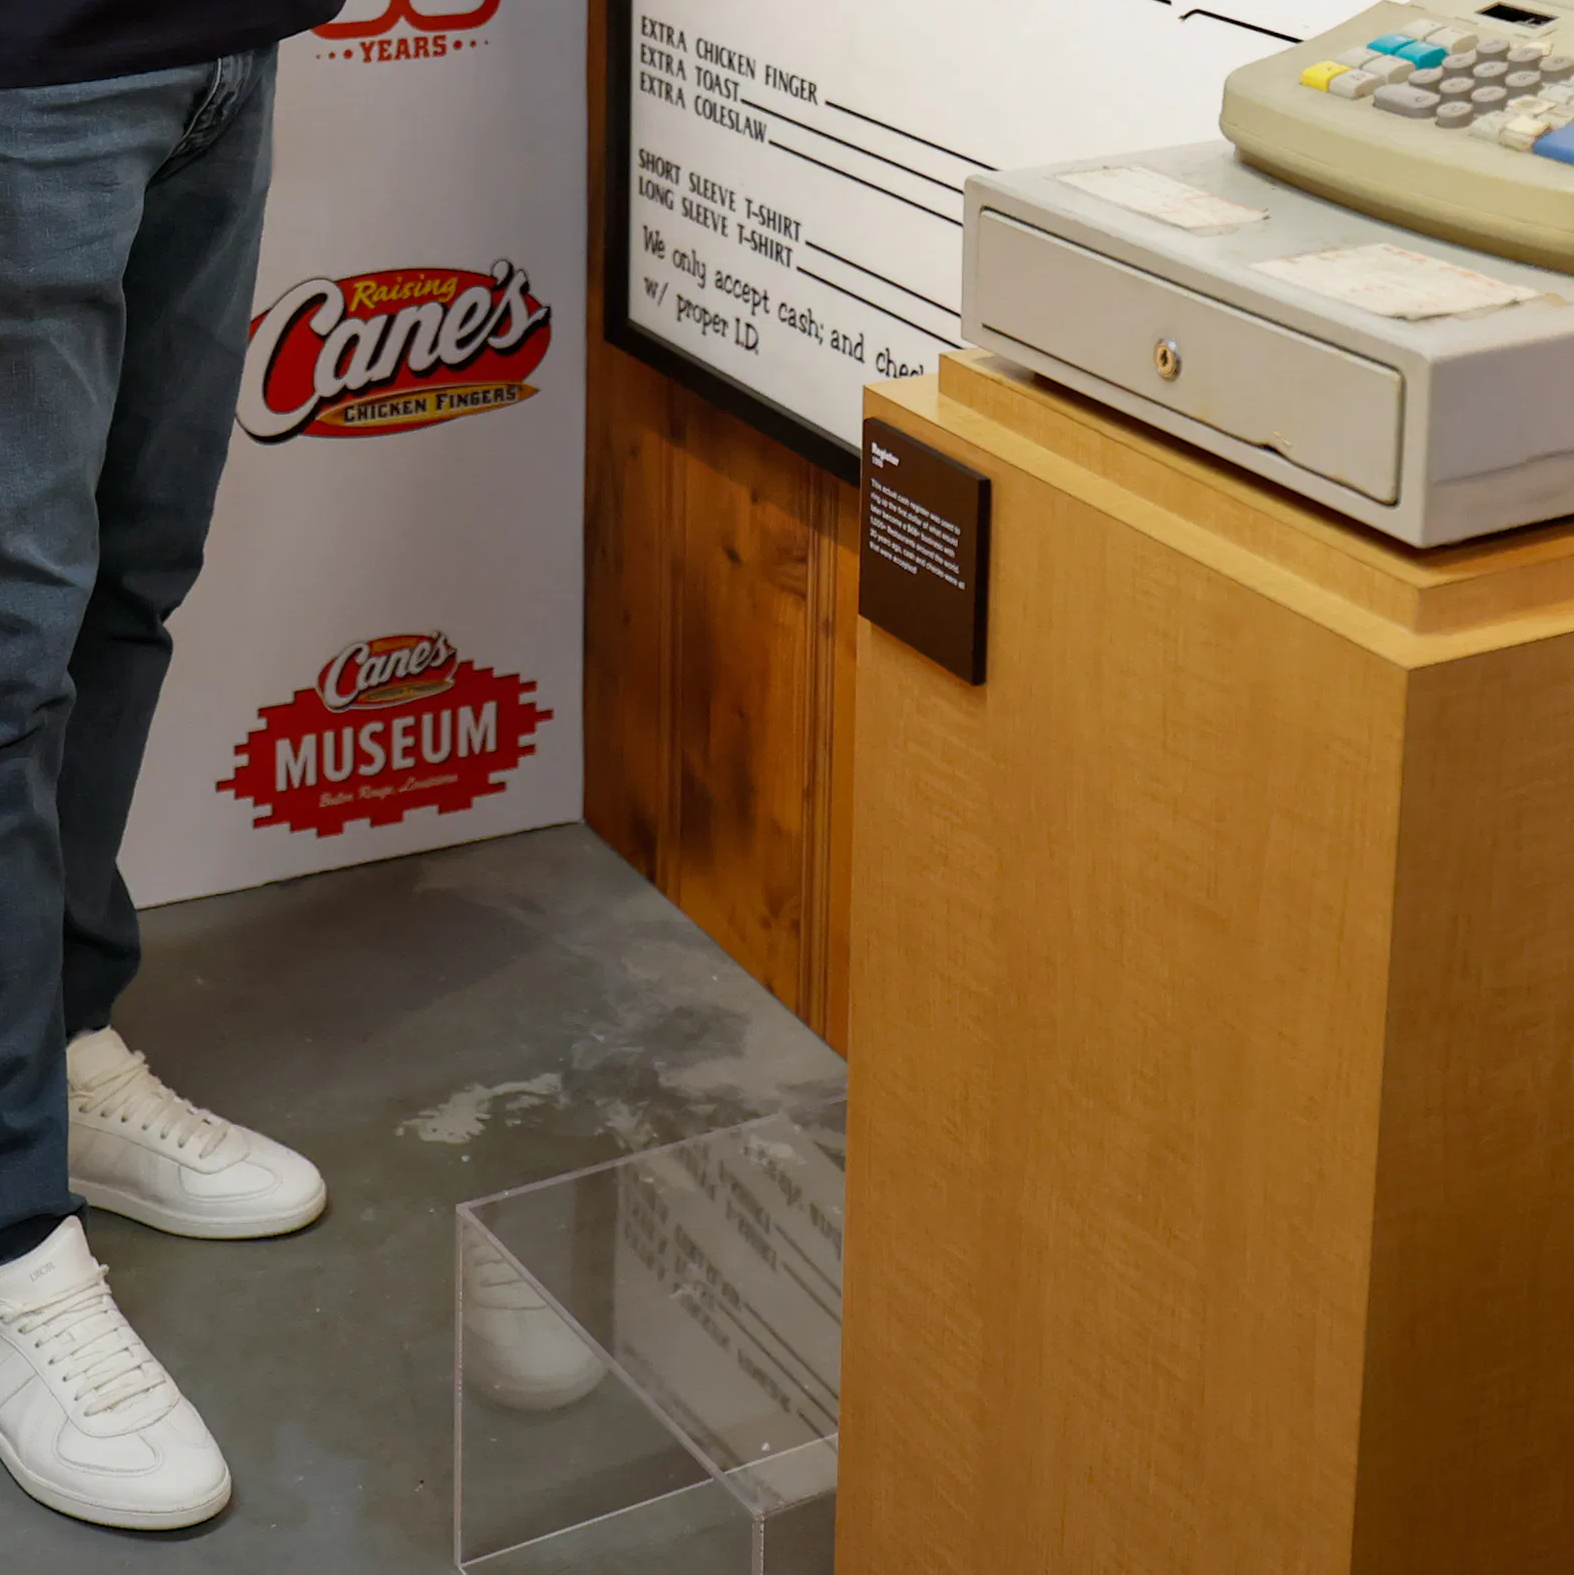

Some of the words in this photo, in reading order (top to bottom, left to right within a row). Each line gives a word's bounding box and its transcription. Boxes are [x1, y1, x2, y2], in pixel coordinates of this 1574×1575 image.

[360, 35, 448, 63] YEARS
[643, 225, 665, 260] We
[673, 249, 706, 289] only
[715, 270, 770, 316] accept
[830, 325, 865, 364] and
[643, 276, 669, 307] w/
[676, 293, 728, 338] proper
[735, 317, 759, 355] I.D.
[275, 701, 498, 792] MUSEUM
